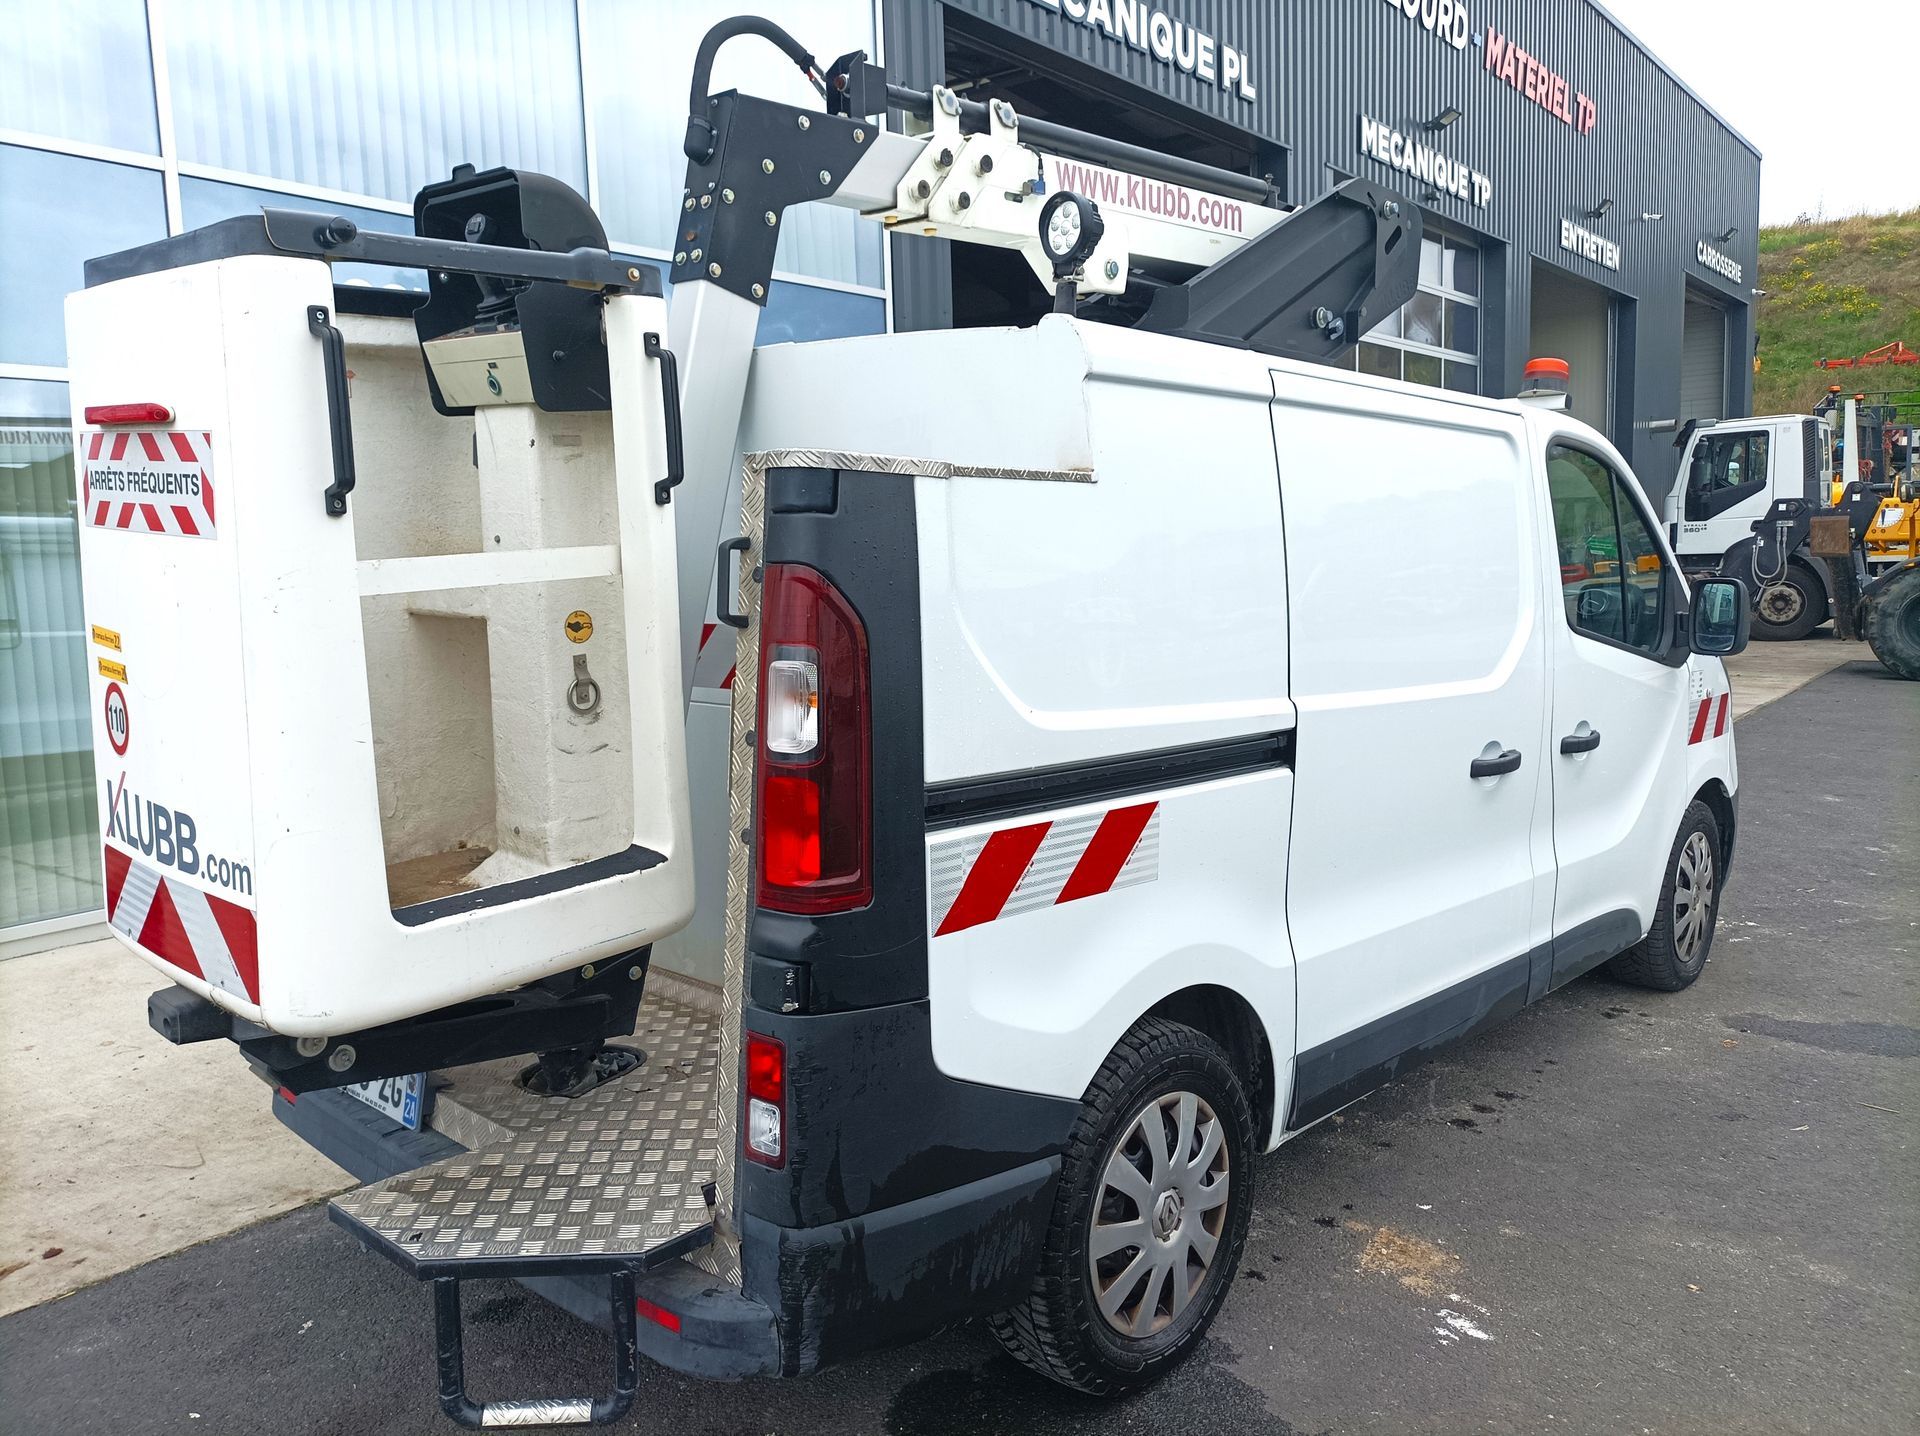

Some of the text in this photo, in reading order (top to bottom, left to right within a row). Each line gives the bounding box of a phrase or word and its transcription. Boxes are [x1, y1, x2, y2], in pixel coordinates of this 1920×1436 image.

[1222, 45, 1256, 100] PL
[1485, 26, 1573, 125] MATERIEL
[1576, 90, 1596, 135] TP
[1360, 114, 1491, 209] MECANIQUE TP
[1055, 160, 1243, 233] www.klubb.com
[1561, 218, 1620, 272] ENTRETIEN
[1697, 239, 1742, 285] CARROSSERIE
[89, 466, 200, 496] ARRÊTS FRÉQUENTS
[108, 705, 125, 735] 110
[404, 1099, 415, 1121] 2A
